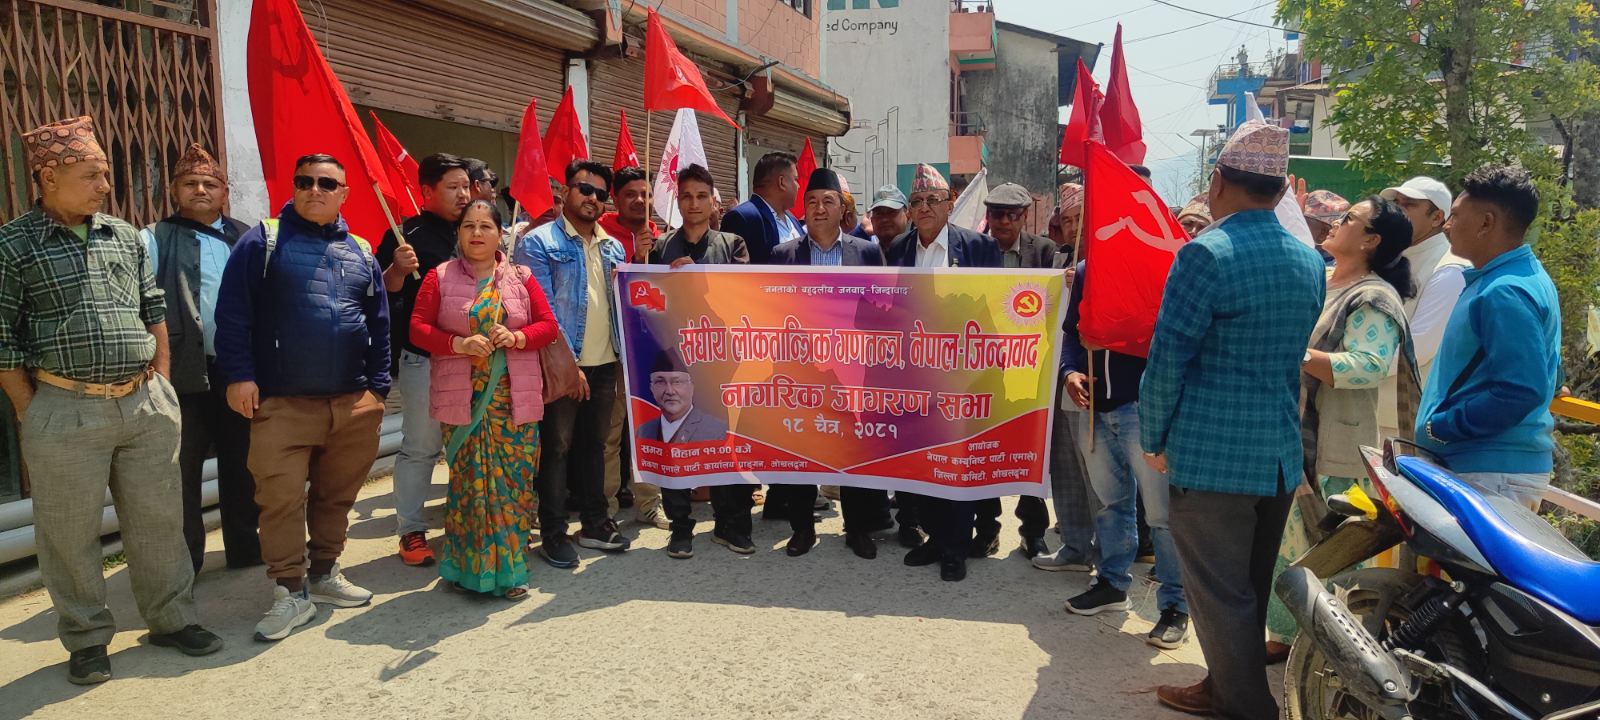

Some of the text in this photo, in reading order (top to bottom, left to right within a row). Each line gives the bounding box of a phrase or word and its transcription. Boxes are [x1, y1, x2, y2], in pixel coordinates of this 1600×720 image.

[841, 18, 898, 35] Company
[679, 315, 728, 367] संघीय
[729, 314, 833, 365] लोकतान्त्रिक
[910, 319, 1042, 372] नेपाल-जिन्दावाद
[720, 374, 993, 421] नागरिक जागरण सभा
[782, 417, 804, 433] १८
[854, 421, 898, 440] २०८१
[968, 441, 1000, 451] आयोजक
[927, 452, 948, 463] नेपाल
[989, 451, 1006, 463] पार्टी
[934, 468, 957, 481] जिल्ला
